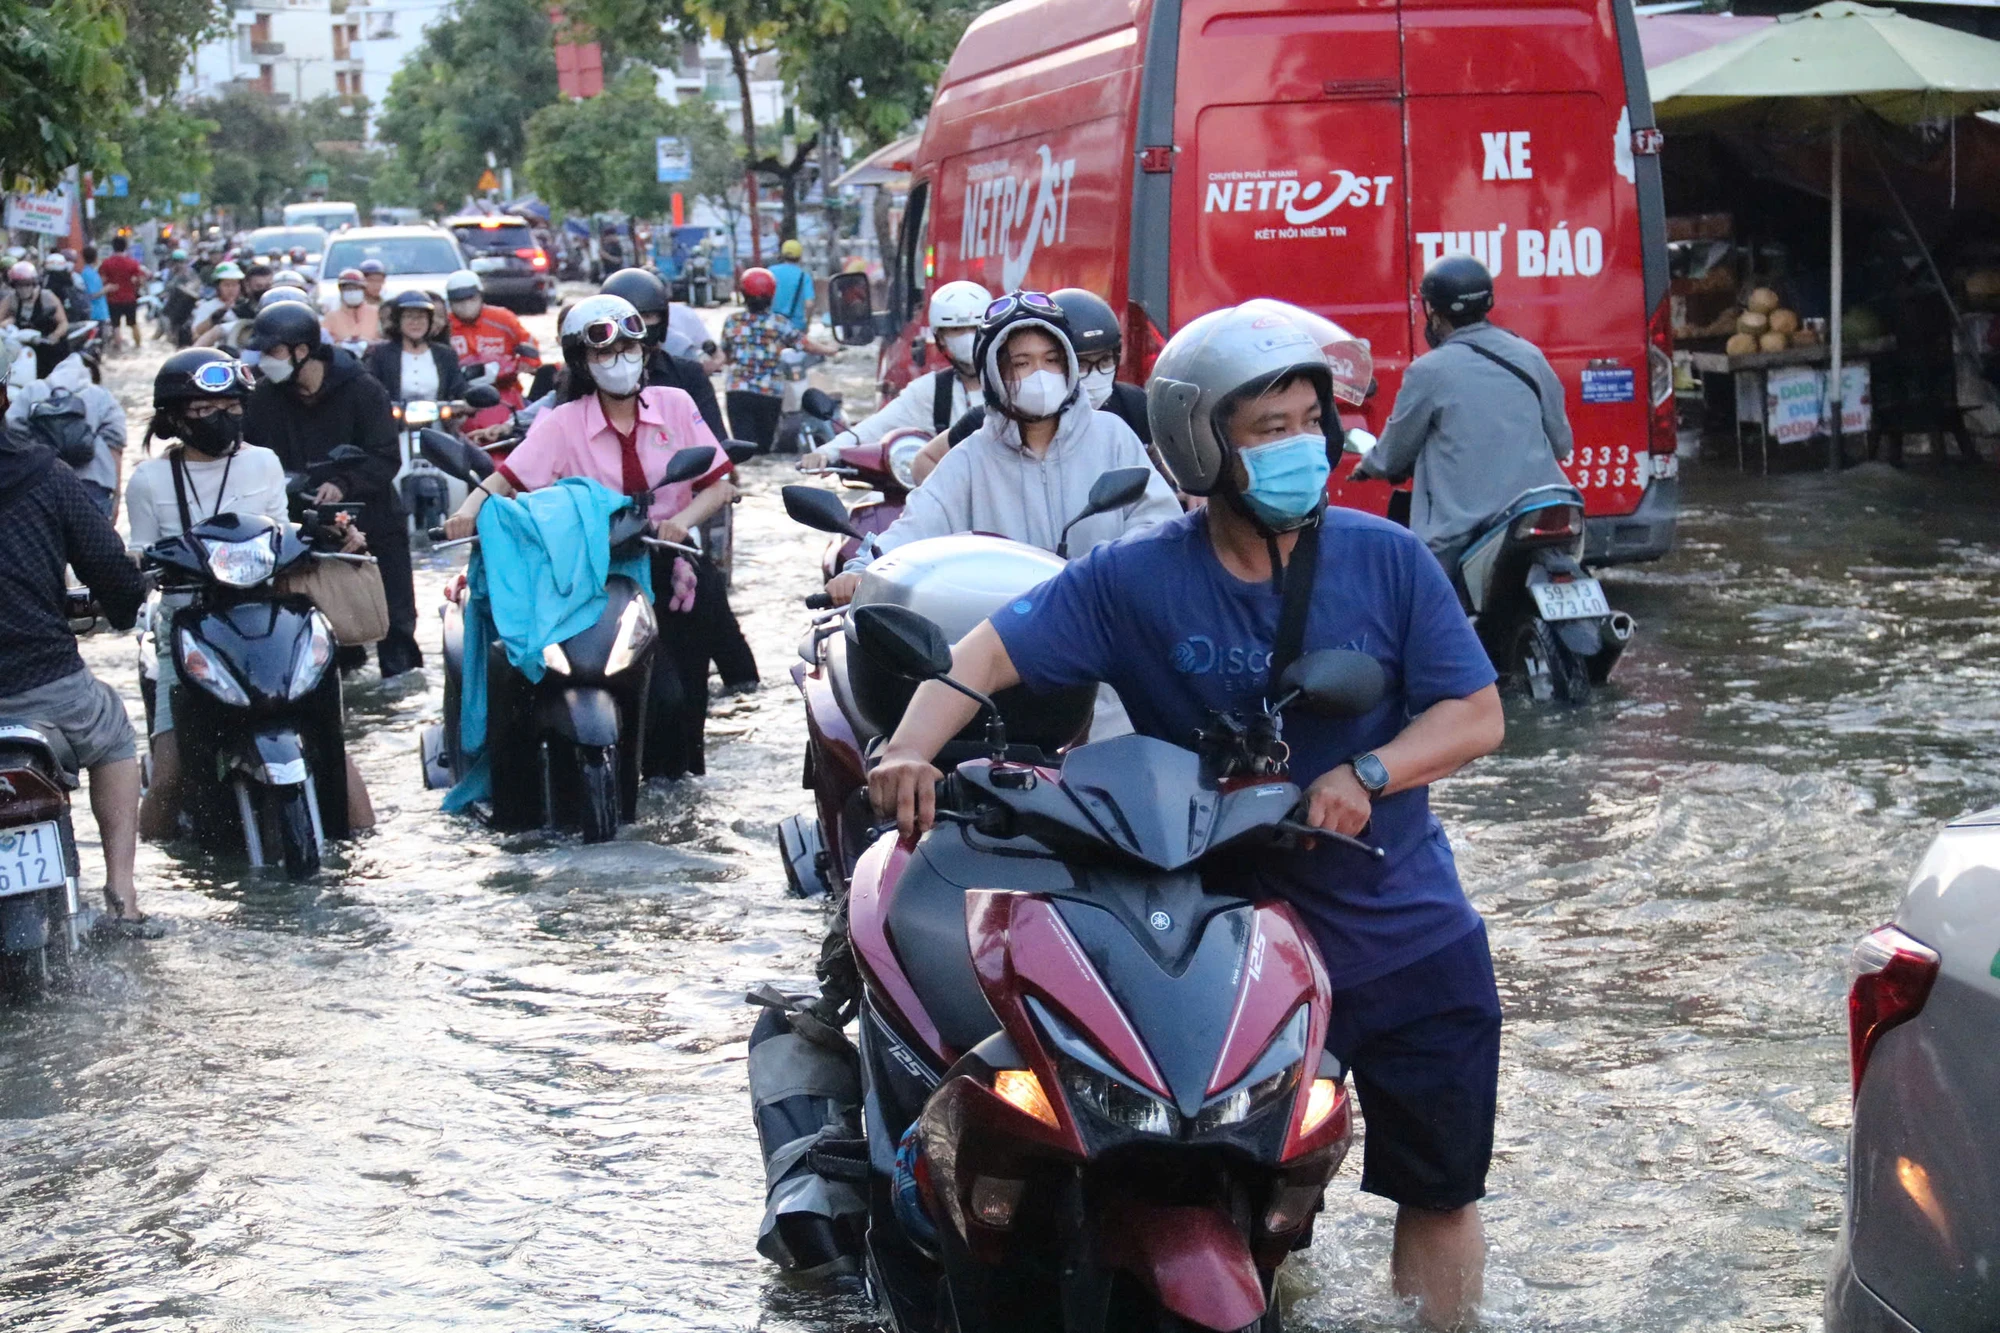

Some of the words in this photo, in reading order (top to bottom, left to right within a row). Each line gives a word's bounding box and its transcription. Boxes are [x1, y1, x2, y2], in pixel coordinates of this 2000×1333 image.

[1481, 131, 1533, 181] XE
[1329, 225, 1347, 237] TIN
[1517, 220, 1603, 278] BÁO
[1248, 931, 1267, 982] 125
[888, 1044, 922, 1077] 125
